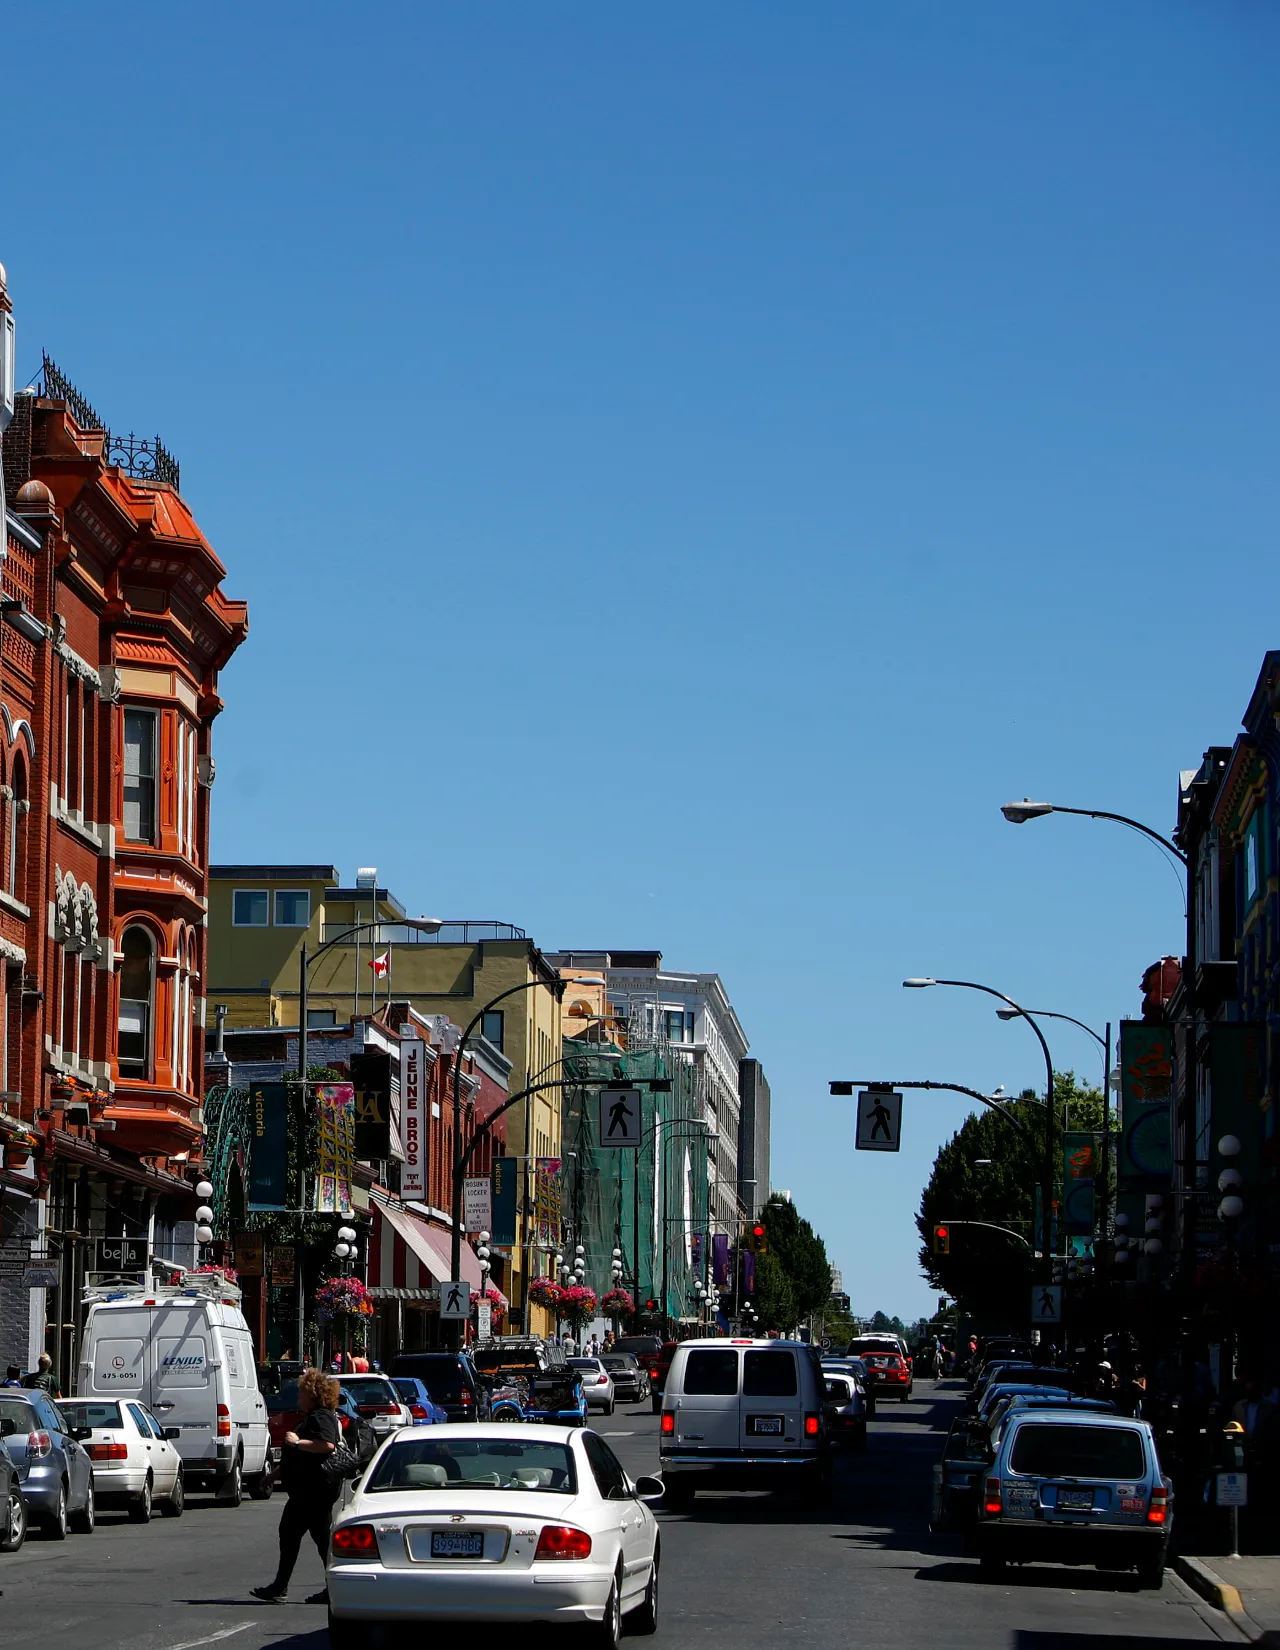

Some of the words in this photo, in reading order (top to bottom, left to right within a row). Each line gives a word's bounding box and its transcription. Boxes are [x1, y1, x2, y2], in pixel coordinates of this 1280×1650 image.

[406, 1049, 418, 1110] JEUNE
[254, 1090, 266, 1137] victoria
[406, 1117, 418, 1166] BROS
[466, 1180, 488, 1188] BOSUN'S
[102, 1242, 136, 1270] bella
[162, 1356, 204, 1366] LENIUS
[434, 1540, 454, 1552] 399
